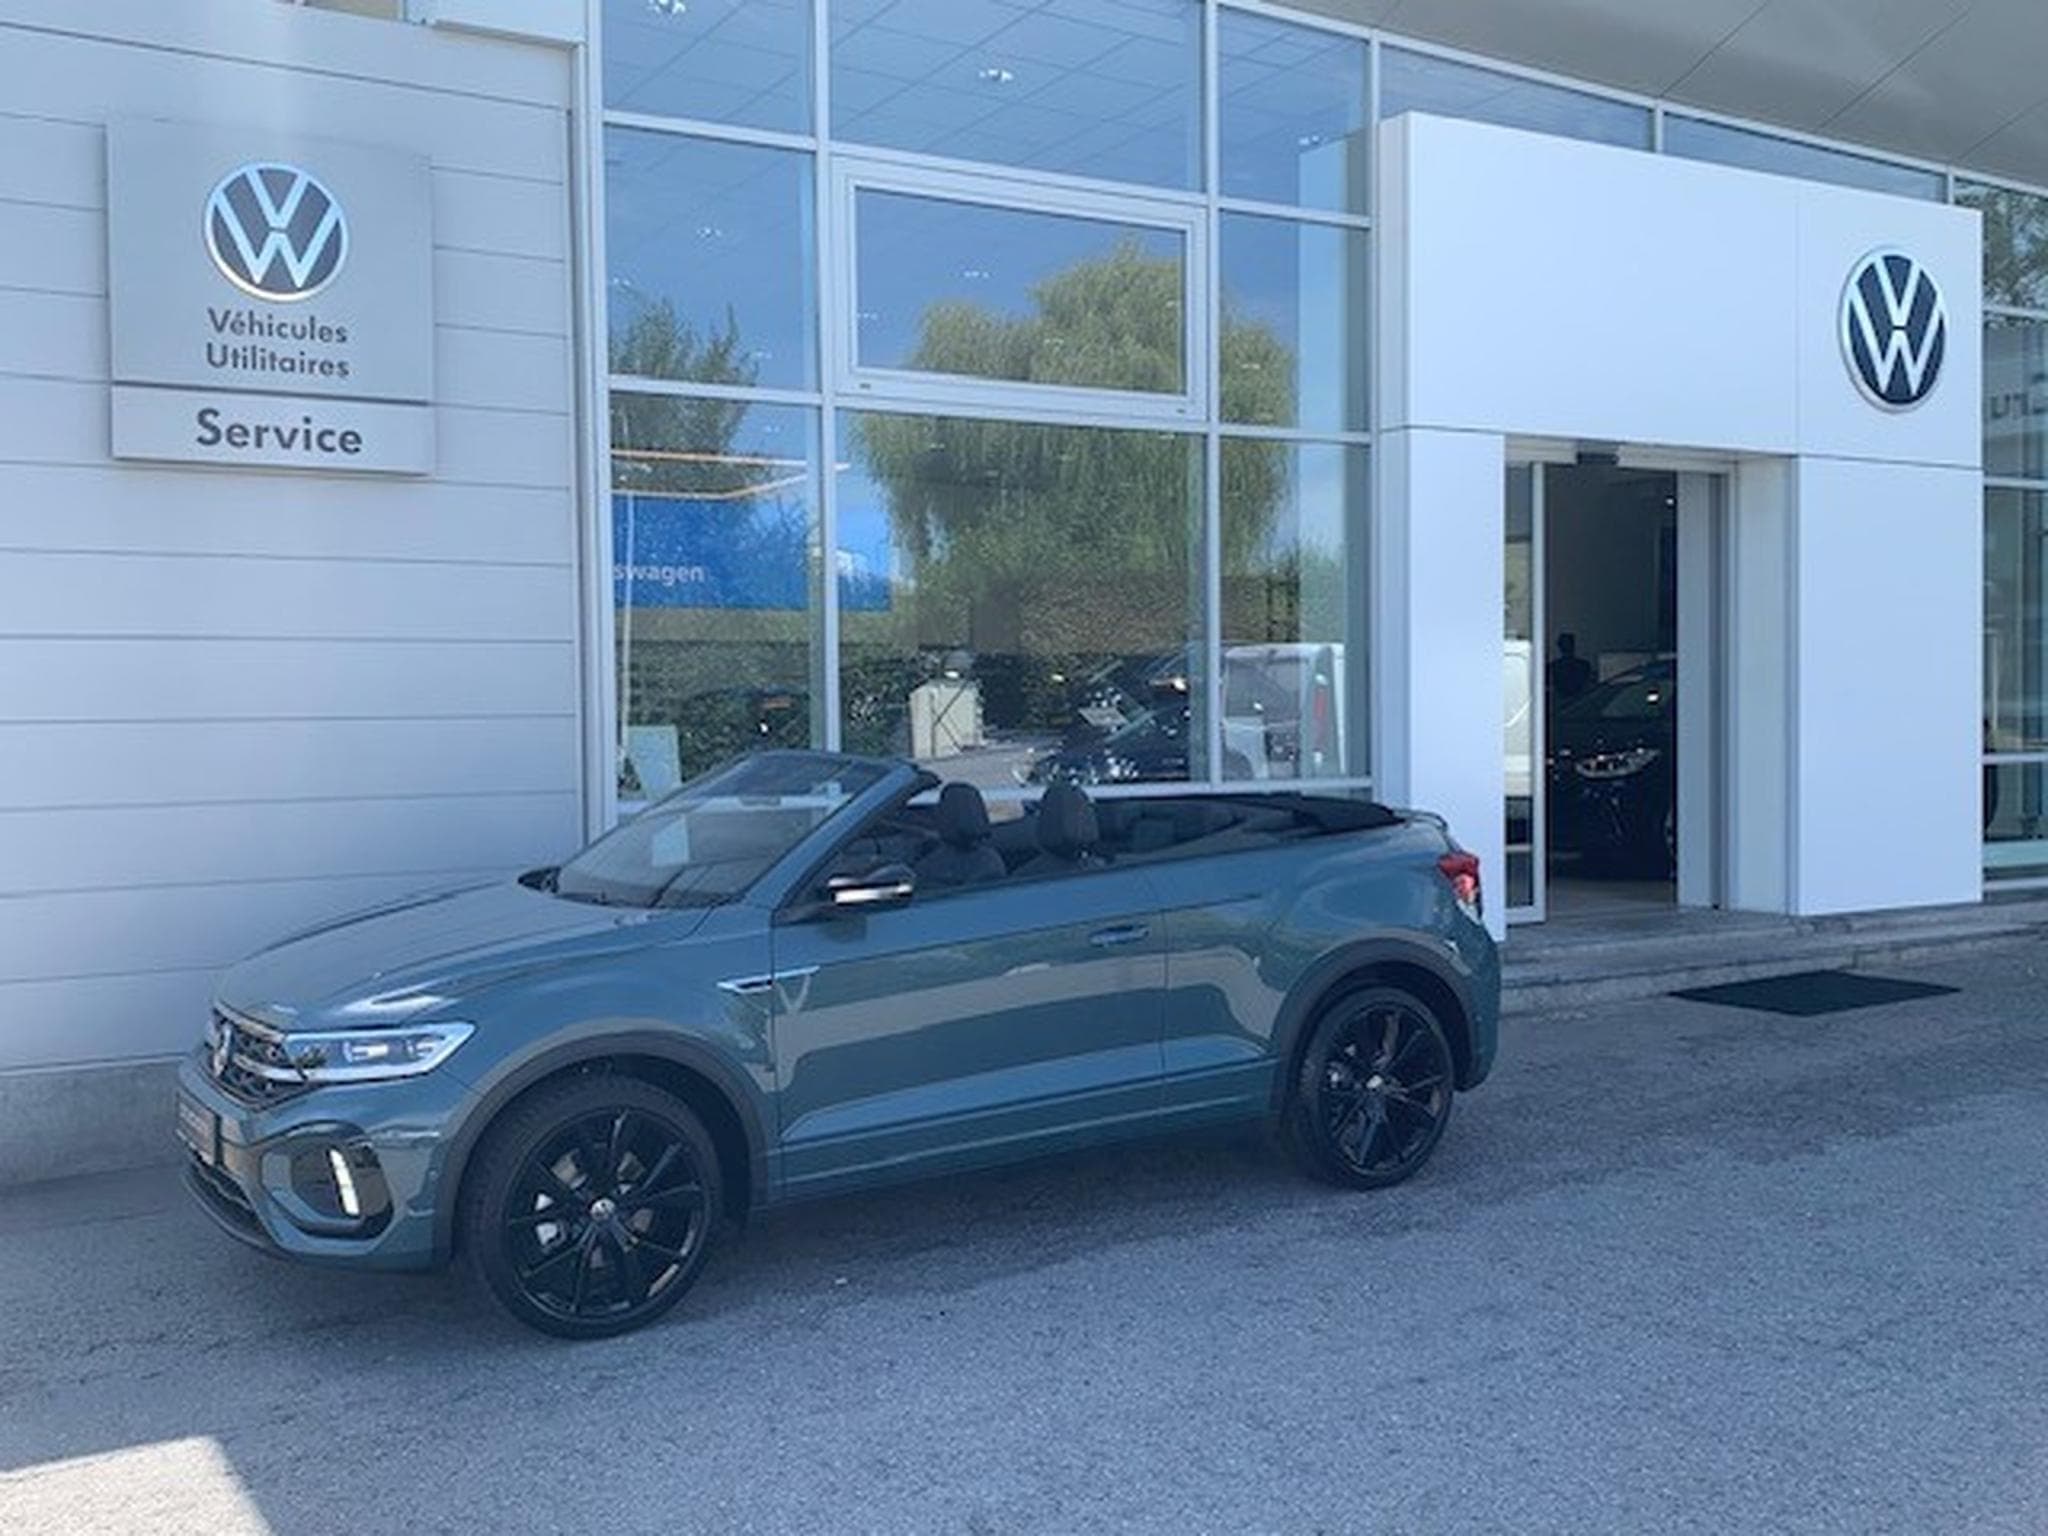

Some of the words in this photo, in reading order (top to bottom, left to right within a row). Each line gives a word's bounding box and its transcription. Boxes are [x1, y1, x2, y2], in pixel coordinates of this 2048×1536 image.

[208, 164, 346, 297] VW
[207, 306, 348, 344] Véhicules
[1843, 249, 1947, 408] VW
[206, 341, 350, 378] Utilitaires
[196, 407, 363, 454] Service
